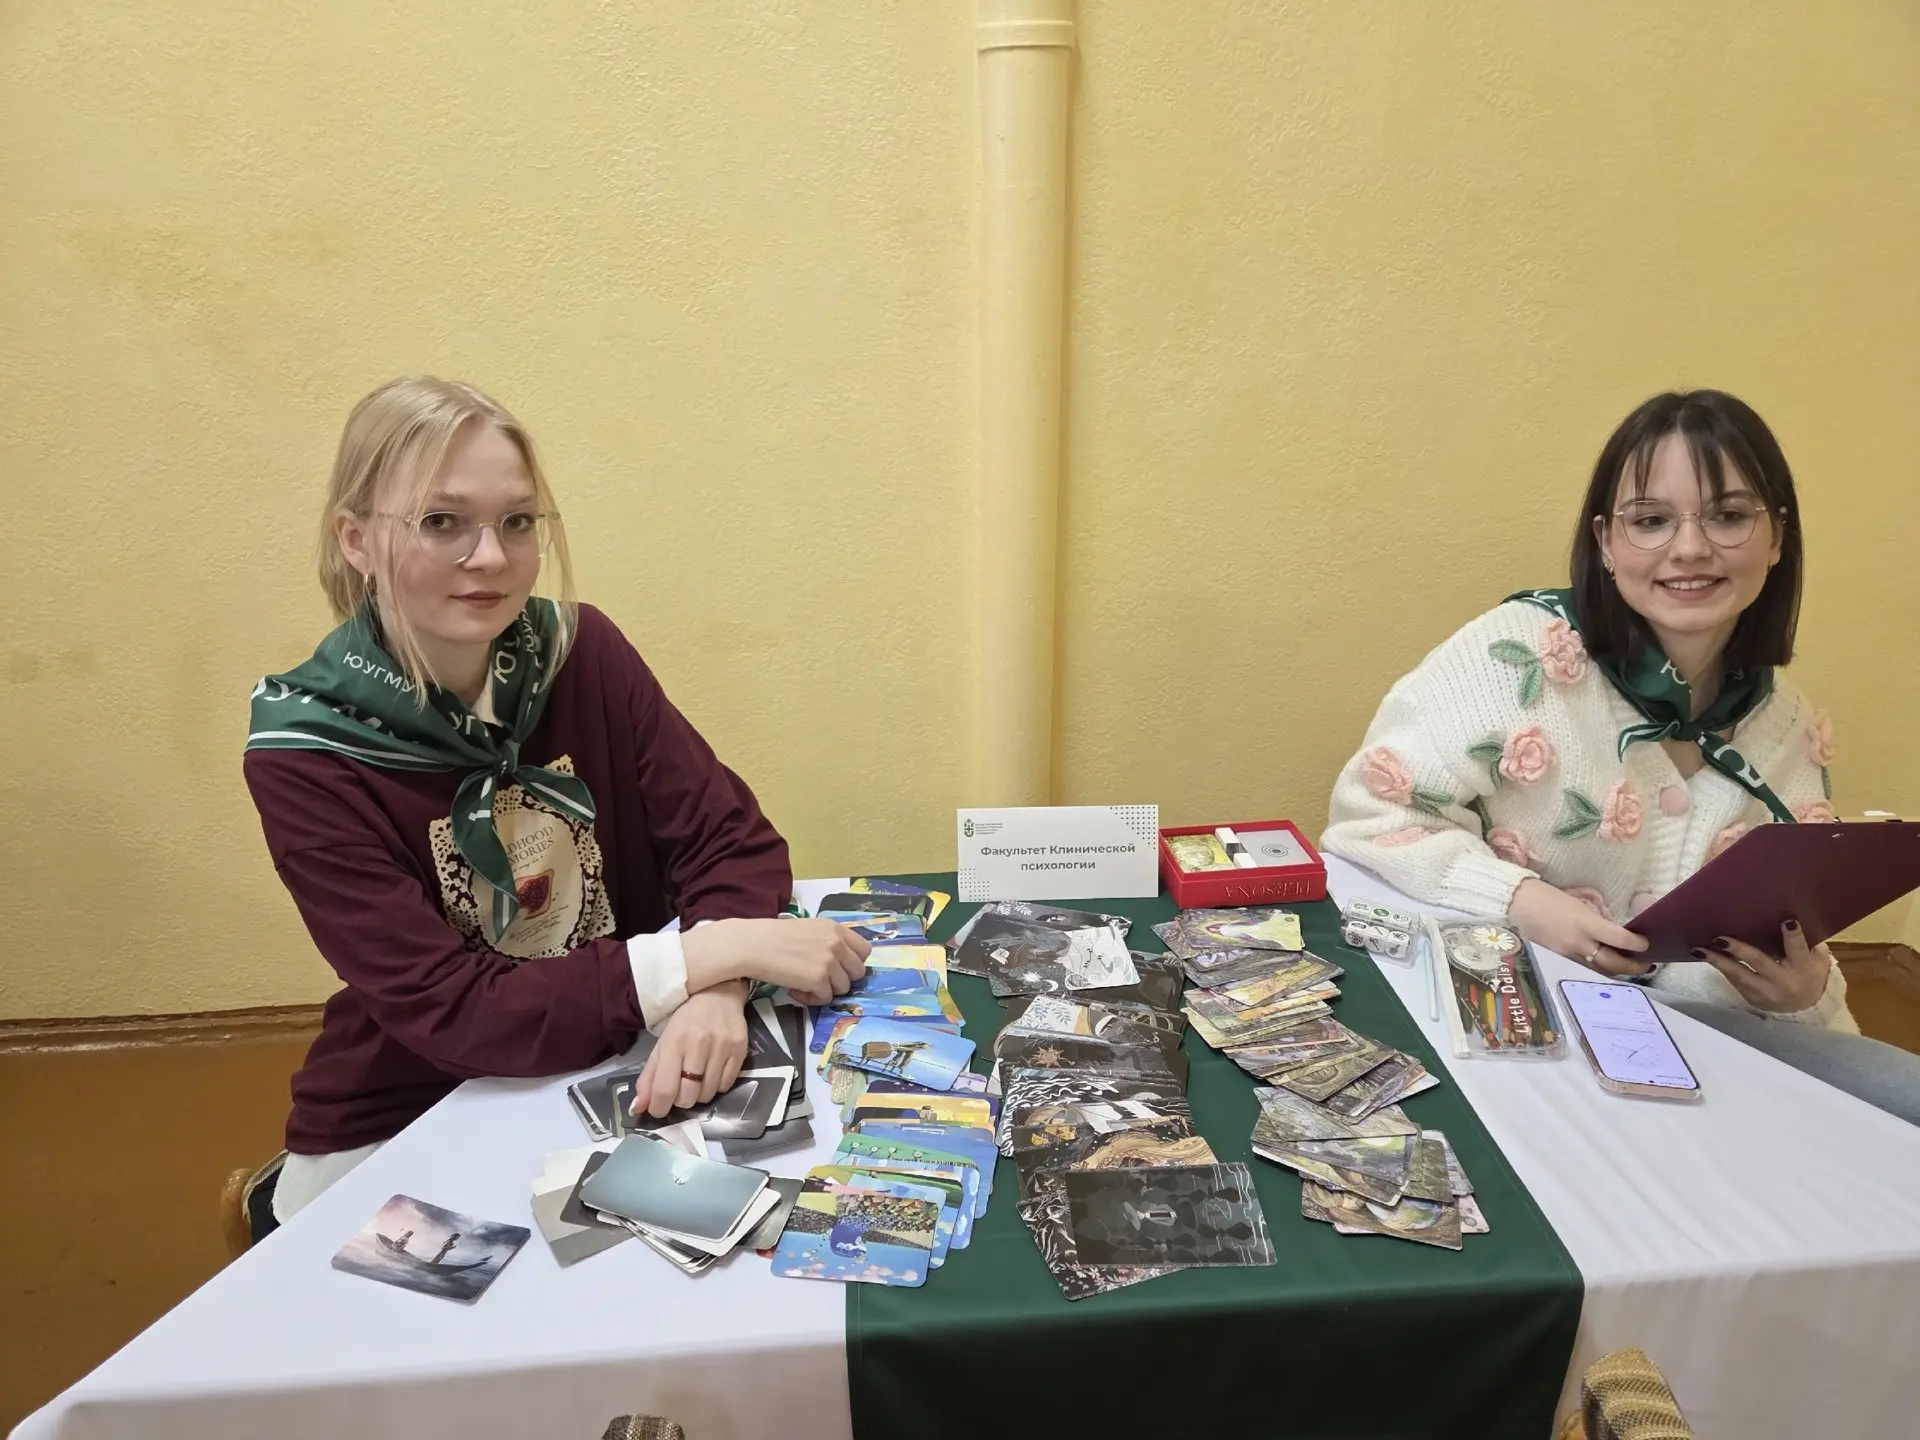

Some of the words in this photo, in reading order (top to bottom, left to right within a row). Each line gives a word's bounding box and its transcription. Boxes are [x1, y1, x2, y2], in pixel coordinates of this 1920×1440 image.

[342, 651, 416, 693] ЮУГМУ
[506, 826, 554, 855] DHOOD
[980, 846, 1047, 858] Факультет
[1049, 843, 1136, 855] Клинической
[1020, 861, 1096, 871] психологии
[1224, 880, 1311, 898] PERSONA
[1509, 998, 1531, 1034] Little
